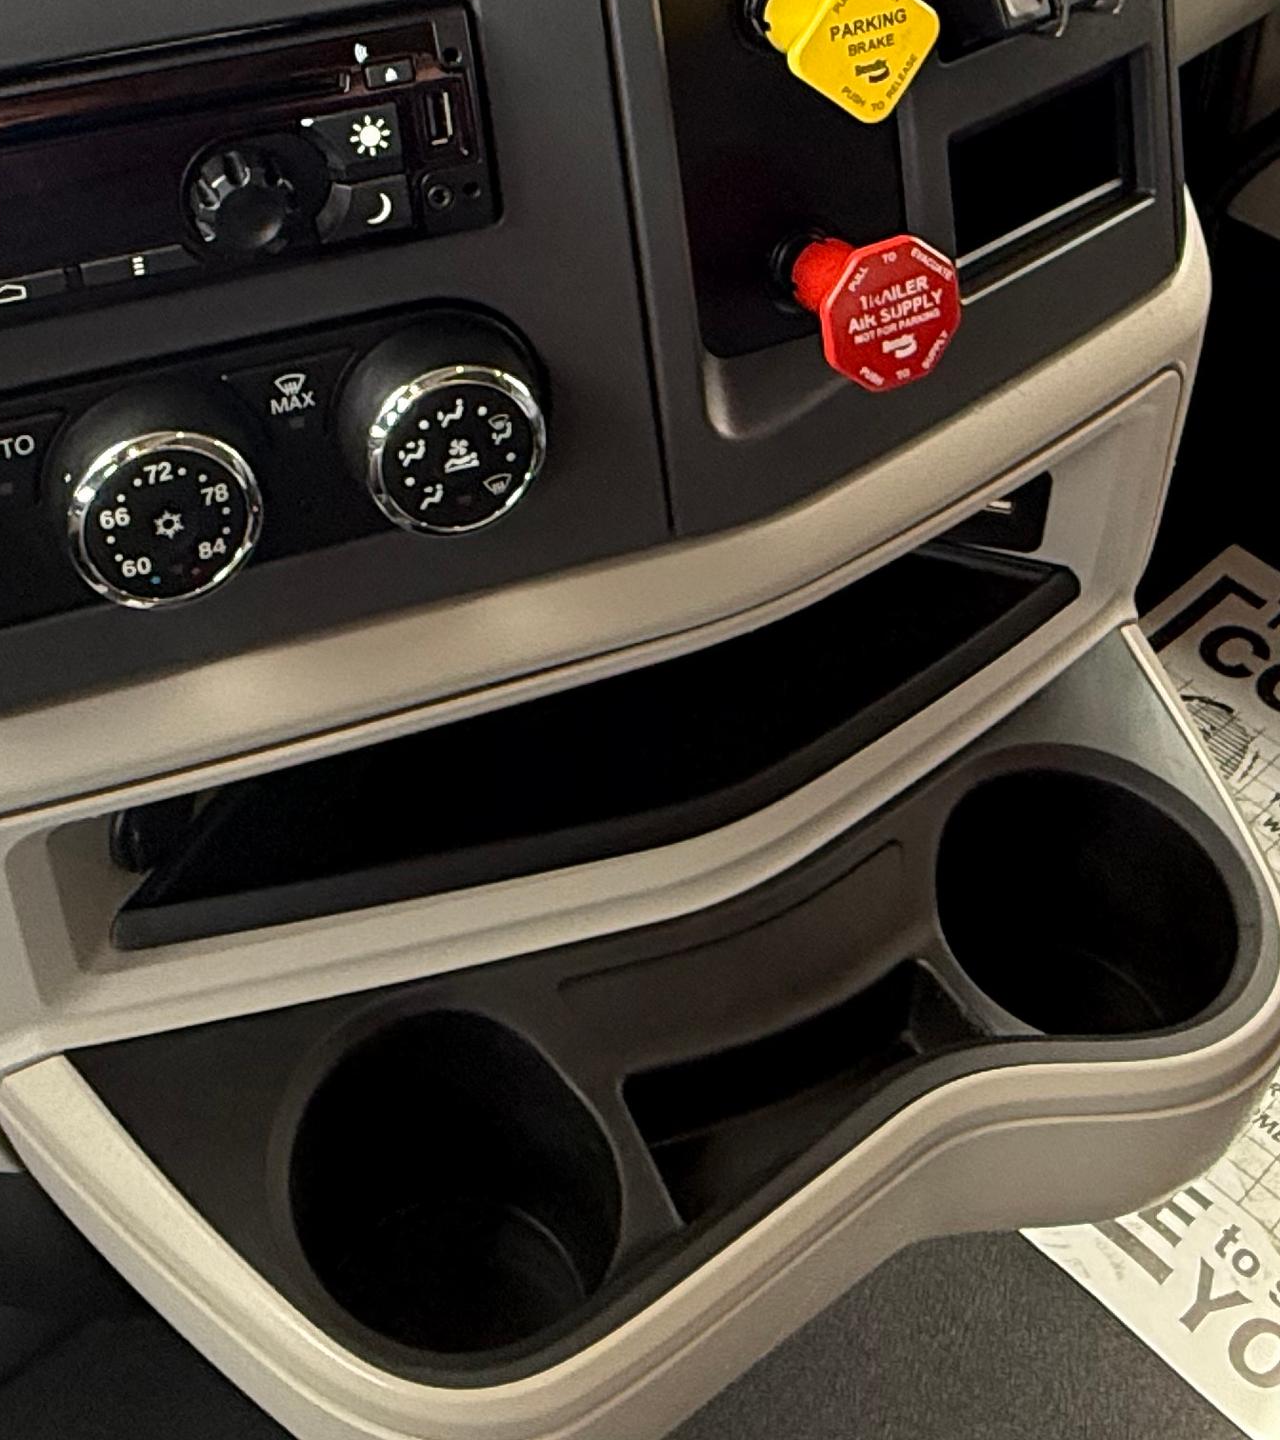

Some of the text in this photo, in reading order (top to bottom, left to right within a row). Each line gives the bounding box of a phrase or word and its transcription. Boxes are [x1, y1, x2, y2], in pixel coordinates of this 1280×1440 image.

[830, 8, 907, 42] PARKING
[848, 33, 895, 57] BRAKE
[841, 86, 866, 107] PUSH
[871, 100, 885, 112] TO
[886, 53, 918, 99] RELEASE
[882, 251, 897, 264] TO
[860, 275, 930, 310] TRAILER
[848, 288, 942, 335] AIR SUPPLY
[269, 391, 316, 415] MAX
[143, 461, 174, 485] 72
[201, 482, 230, 507] 78
[99, 506, 131, 530] 66
[197, 536, 227, 560] 84
[121, 556, 152, 578] 60
[1214, 1224, 1261, 1278] to
